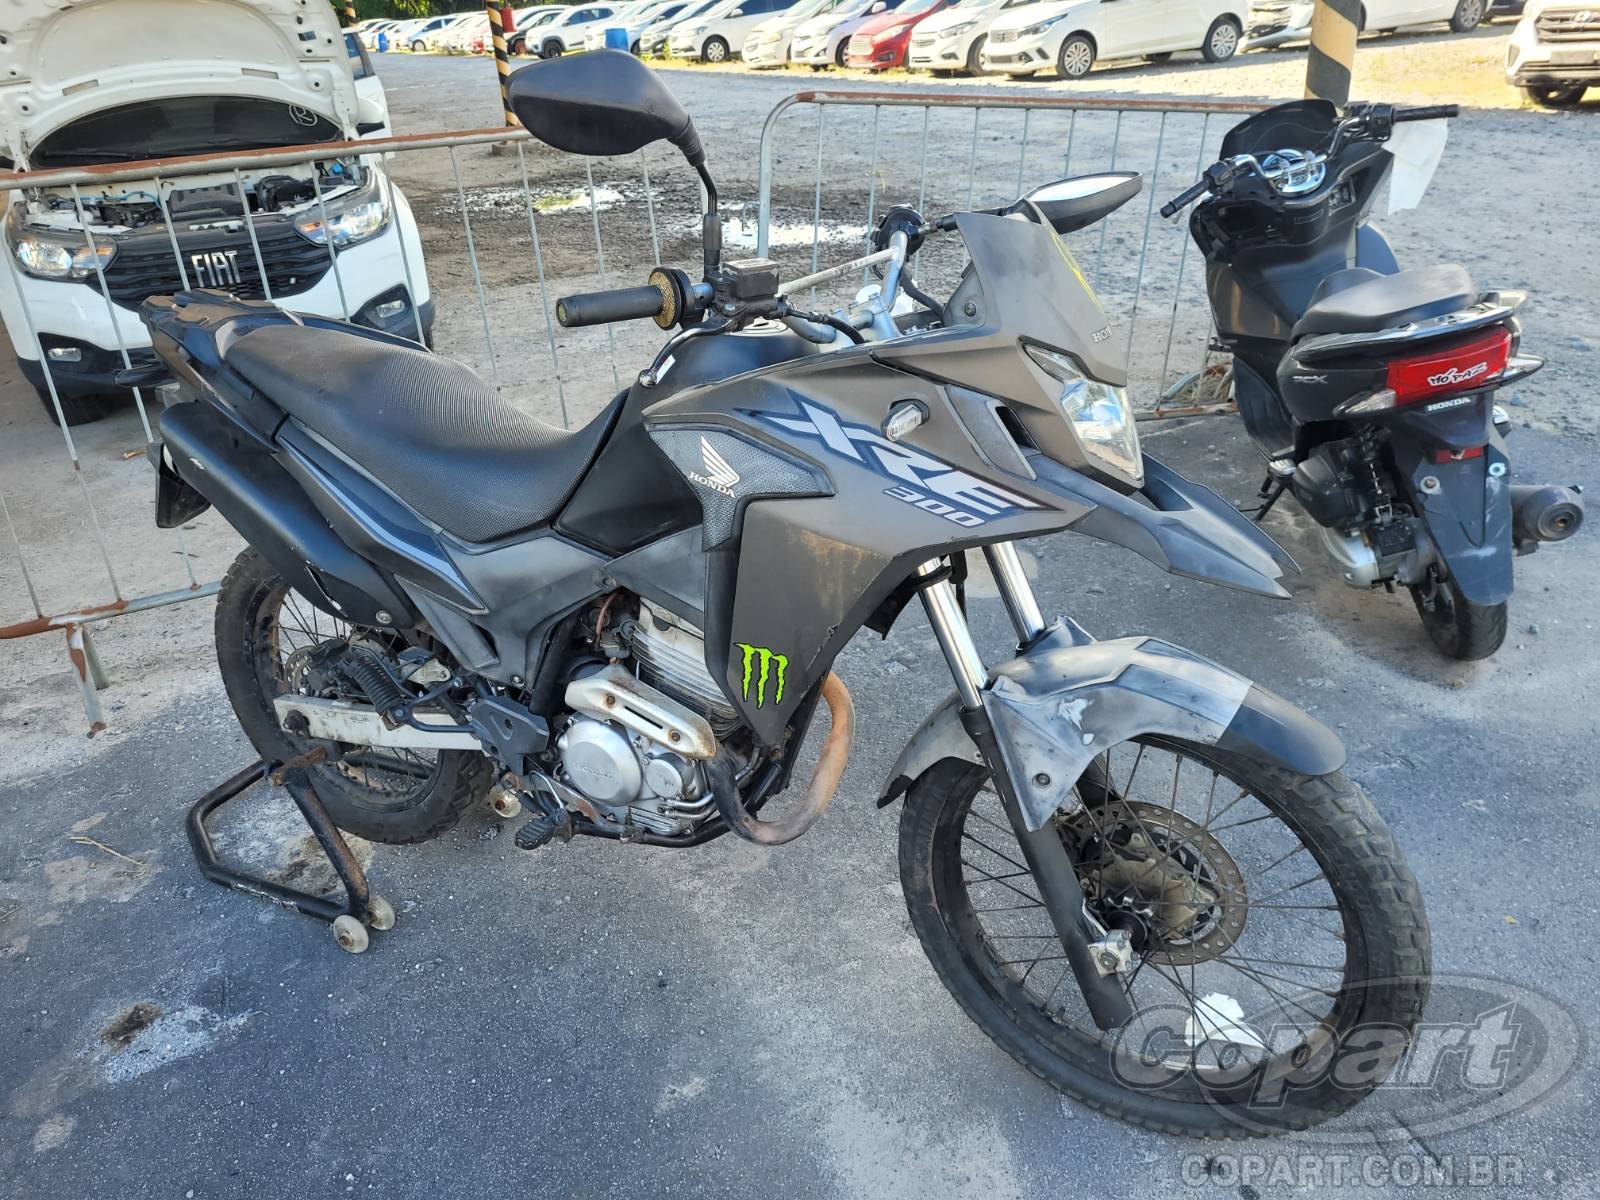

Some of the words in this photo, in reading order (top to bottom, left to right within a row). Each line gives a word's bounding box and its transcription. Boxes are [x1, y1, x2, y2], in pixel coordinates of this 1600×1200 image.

[191, 250, 241, 288] FIAT
[1427, 397, 1471, 412] HONDA
[745, 392, 1055, 517] XRE
[688, 471, 737, 499] HONDA
[883, 485, 985, 528] 300
